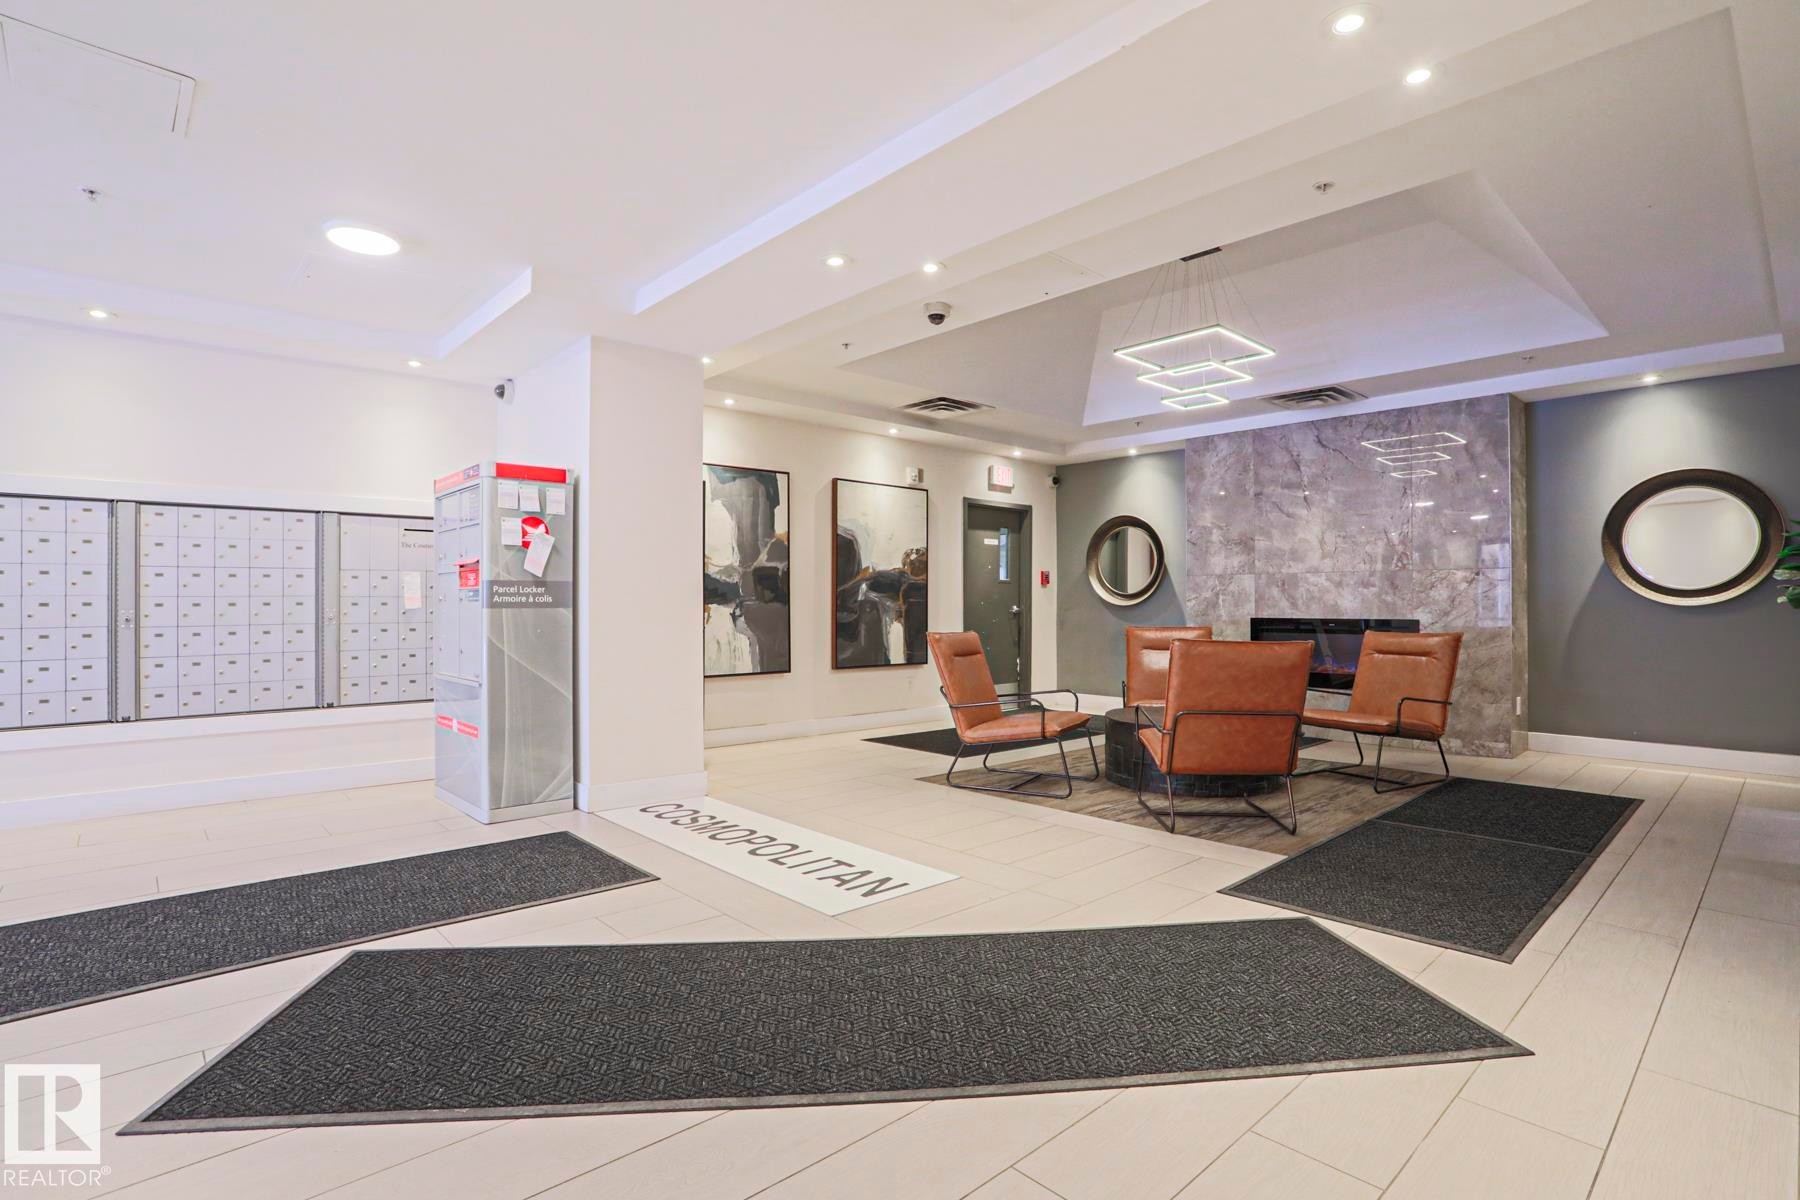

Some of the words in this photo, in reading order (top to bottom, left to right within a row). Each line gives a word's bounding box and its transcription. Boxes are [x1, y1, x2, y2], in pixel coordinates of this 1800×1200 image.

[493, 585, 518, 594] Parcel
[519, 585, 545, 594] Locker
[493, 595, 527, 603] Armoire
[528, 594, 534, 603] à
[535, 594, 553, 603] colis
[639, 803, 909, 898] COSMOPOLITAN
